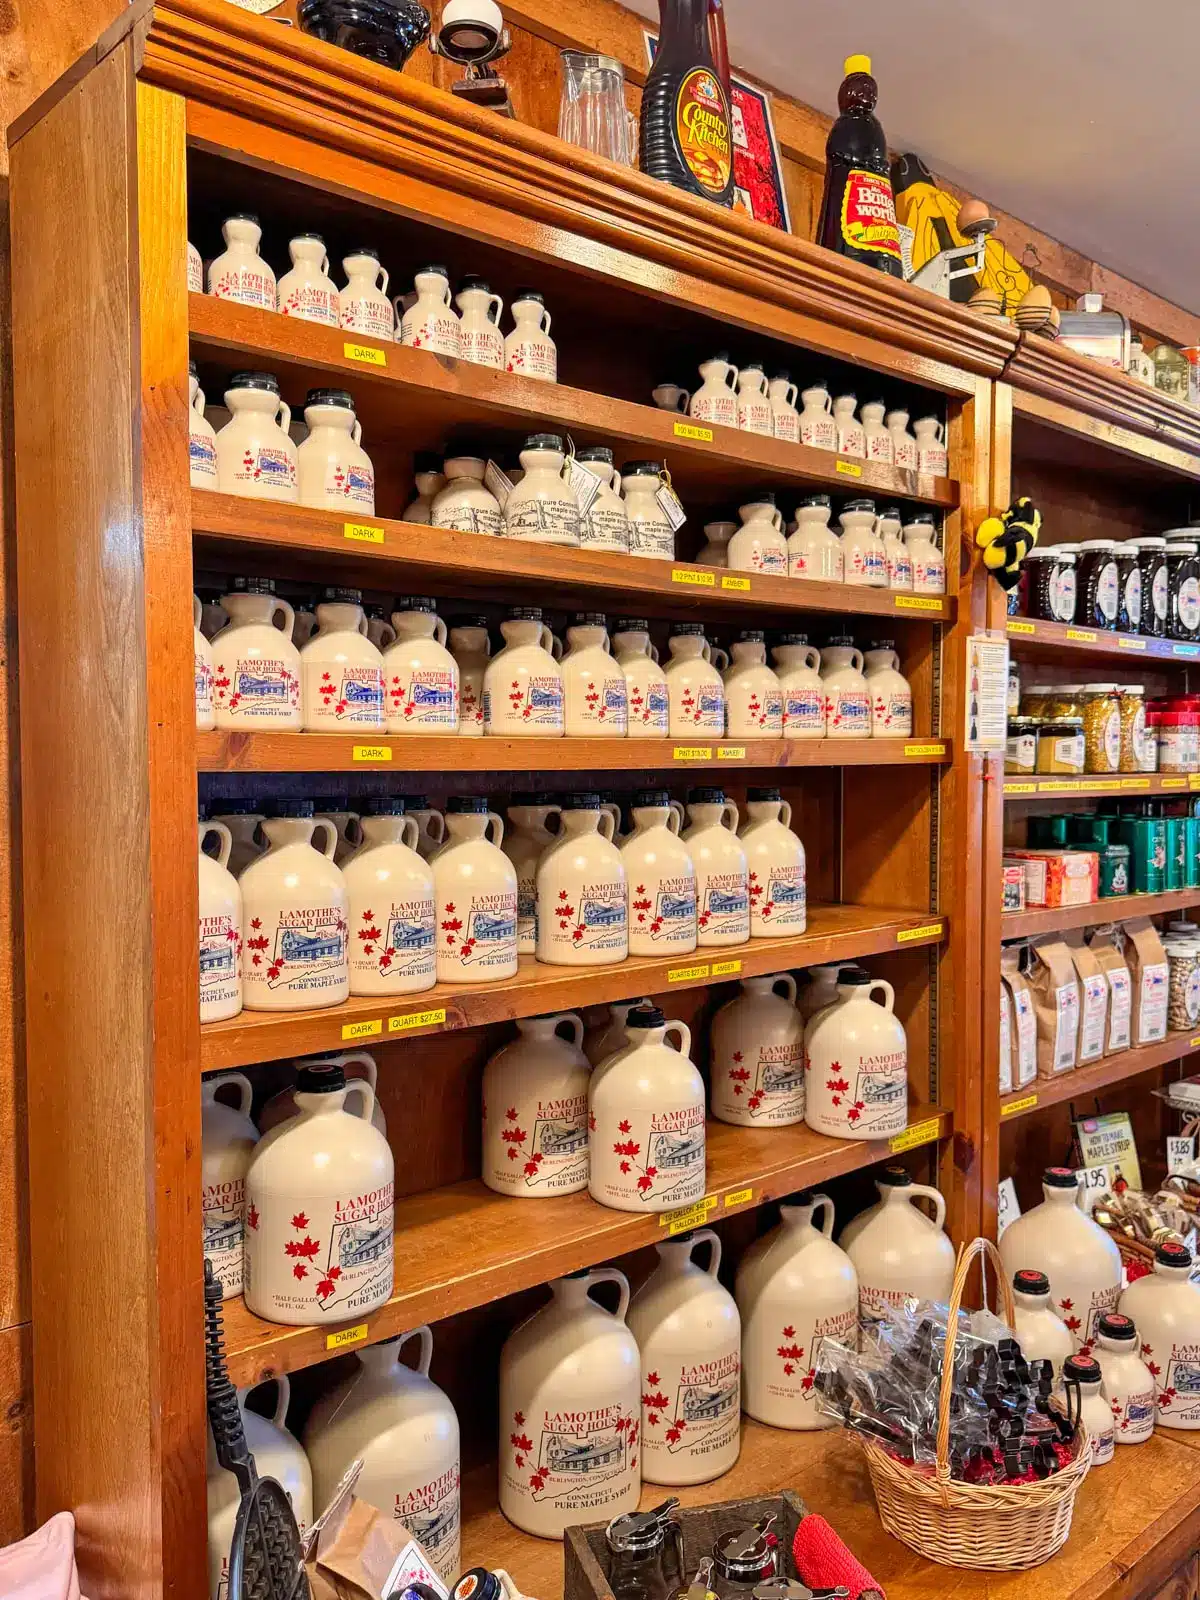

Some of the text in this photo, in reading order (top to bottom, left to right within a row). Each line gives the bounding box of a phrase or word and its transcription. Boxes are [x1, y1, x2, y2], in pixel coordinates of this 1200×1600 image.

[683, 102, 727, 138] Country
[688, 119, 728, 154] Kitchen
[354, 348, 377, 360] DARK
[542, 500, 557, 508] pure
[550, 507, 568, 515] maple
[592, 509, 605, 517] pure
[600, 517, 616, 525] maple
[638, 520, 651, 529] pure
[352, 527, 376, 538] DARK
[645, 527, 661, 535] maple
[237, 659, 285, 667] LAMOTHE'S
[361, 749, 384, 757] DARK
[769, 872, 792, 880] SUGAR
[706, 880, 731, 888] SUGAR
[470, 903, 499, 911] SUGAR
[279, 906, 342, 920] LAMOTHE'S
[390, 910, 419, 918] SUGAR
[278, 915, 342, 928] SUGAR HOUSE
[203, 925, 233, 936] HOUSE
[496, 957, 511, 965] MAPLE
[717, 963, 735, 972] AMBER
[299, 974, 335, 983] CONNECTICUT
[669, 970, 690, 980] QUARTS
[288, 983, 308, 991] PURE
[310, 980, 332, 989] MAPLE
[392, 1012, 443, 1028] QUART $27.50
[350, 1024, 373, 1035] DARK
[759, 1053, 788, 1062] SUGAR
[859, 1063, 889, 1072] SUGAR
[536, 1109, 571, 1119] SUGAR
[650, 1121, 685, 1132] SUGAR
[1089, 1129, 1124, 1145] HOW TO MAKE
[1086, 1139, 1131, 1160] MAPLE SYRUP
[547, 1179, 568, 1188] PURE
[662, 1187, 701, 1202] PURE MAPLE
[334, 1205, 375, 1224] SUGAR
[674, 1206, 694, 1218] GALLON
[674, 1216, 695, 1230] GALLON
[275, 1294, 291, 1302] HALF
[347, 1294, 371, 1308] PURE
[814, 1324, 843, 1336] SUGAR
[335, 1329, 359, 1343] DARK
[680, 1372, 716, 1385] SUGAR
[544, 1402, 622, 1423] LAMOTHE'S
[543, 1414, 621, 1432] SUGAR HOUSE
[690, 1437, 732, 1456] PURE MAPLE
[554, 1483, 632, 1509] PURE MAPLE SYRUP
[566, 1487, 613, 1501] CONNECTICUT
[393, 1494, 435, 1516] SUGAR
